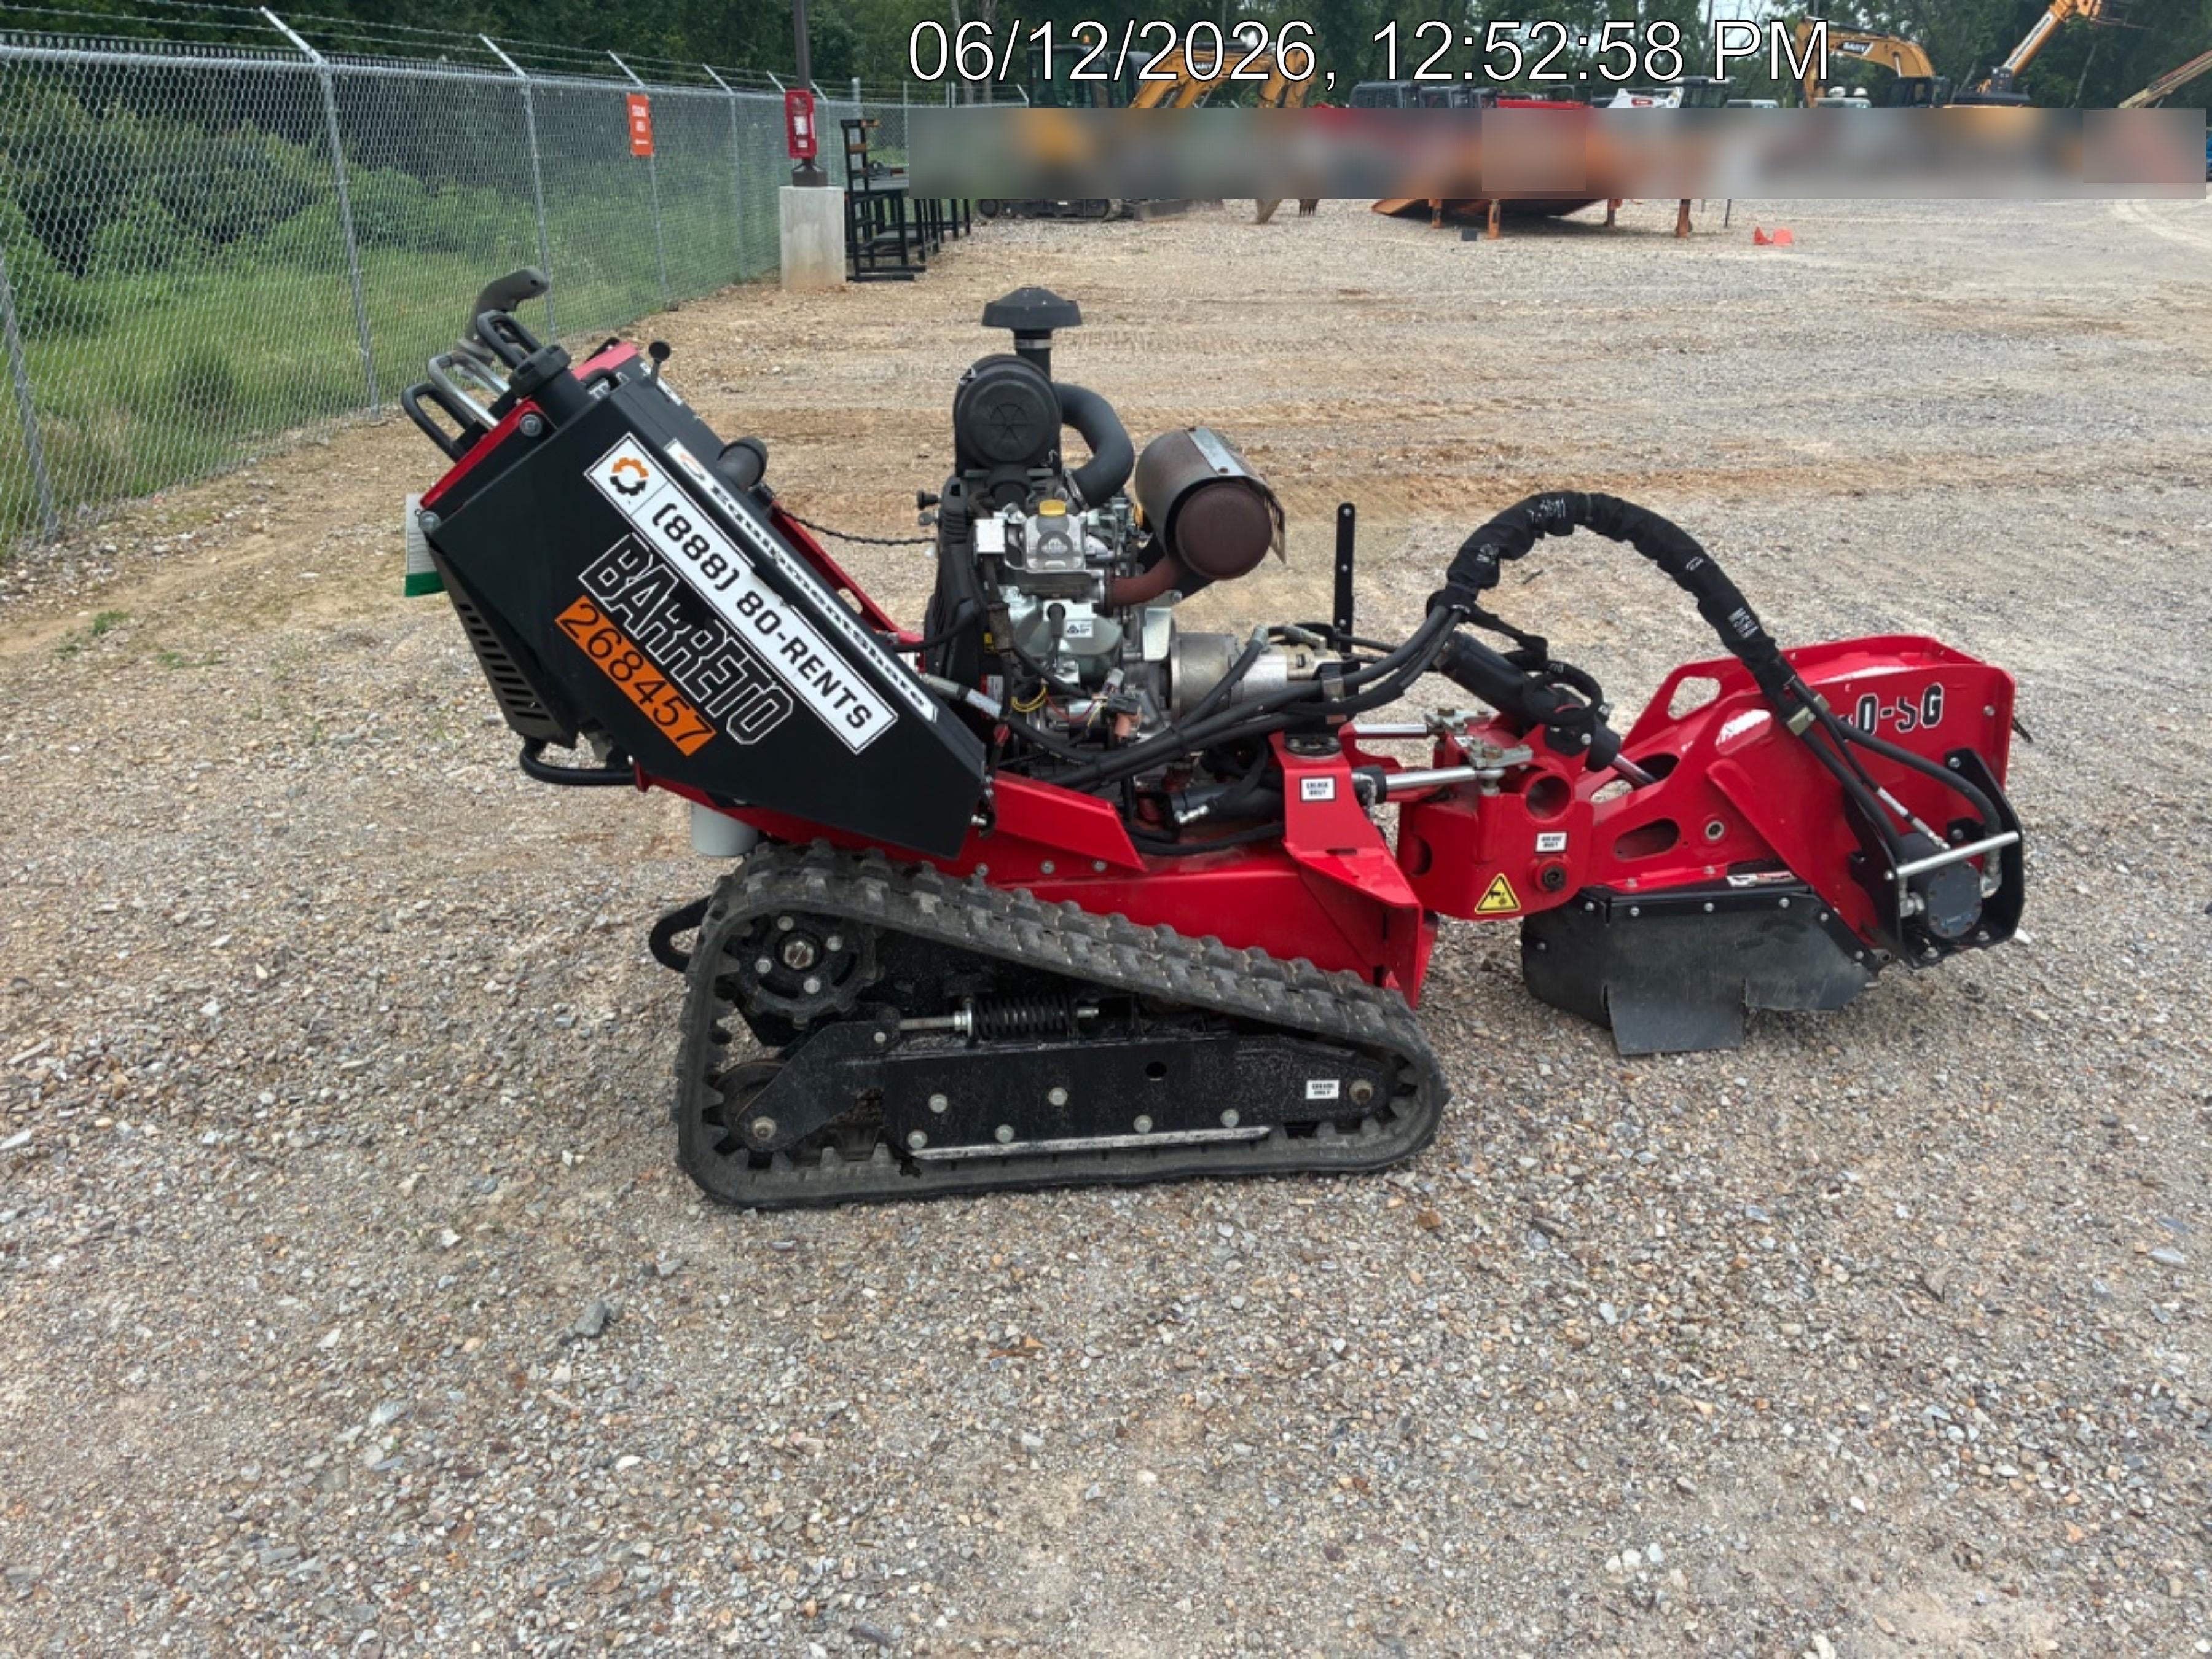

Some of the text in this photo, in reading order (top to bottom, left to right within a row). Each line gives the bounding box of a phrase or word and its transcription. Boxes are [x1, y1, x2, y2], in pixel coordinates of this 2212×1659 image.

[559, 603, 713, 743] 268457
[652, 503, 873, 729] (888) 80-RENTS
